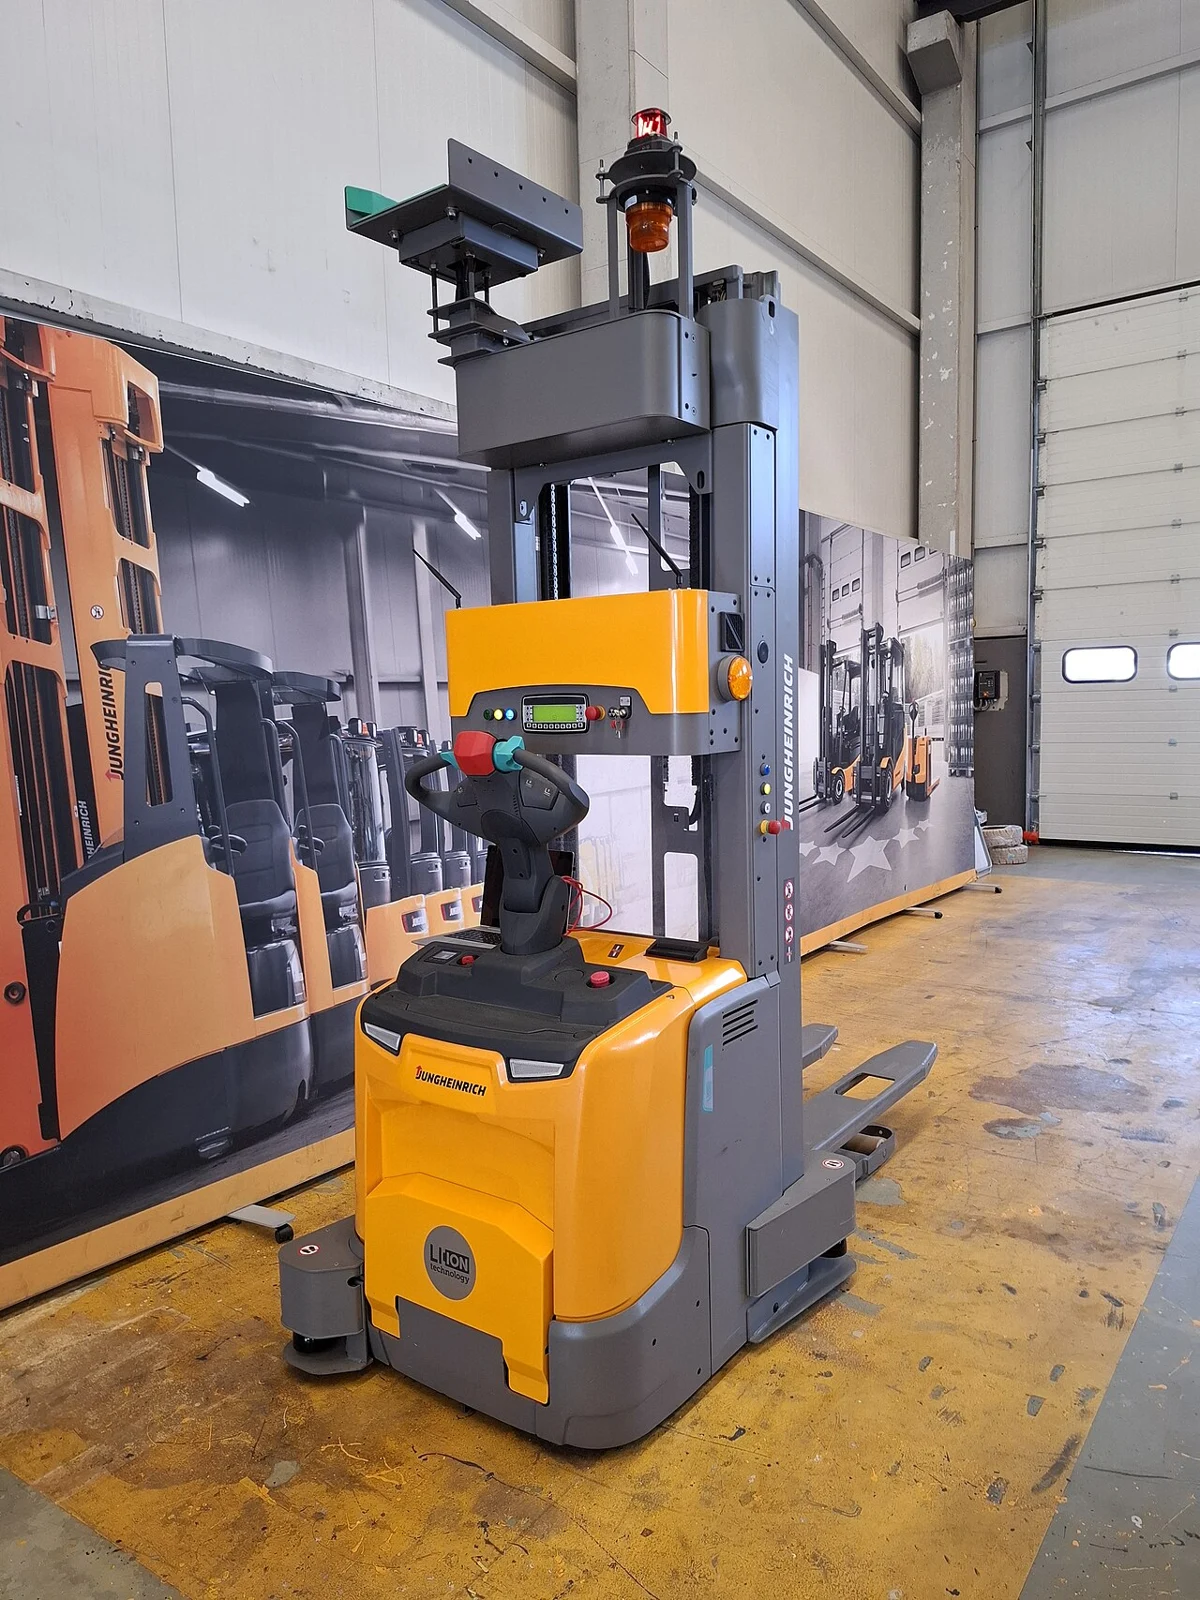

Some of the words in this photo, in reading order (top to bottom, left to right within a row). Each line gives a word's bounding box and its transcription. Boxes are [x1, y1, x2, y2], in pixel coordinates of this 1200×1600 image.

[782, 653, 794, 831] JUNGHEINRICH
[415, 1067, 487, 1096] JUNGHEINRICH
[430, 1263, 470, 1285] technology
